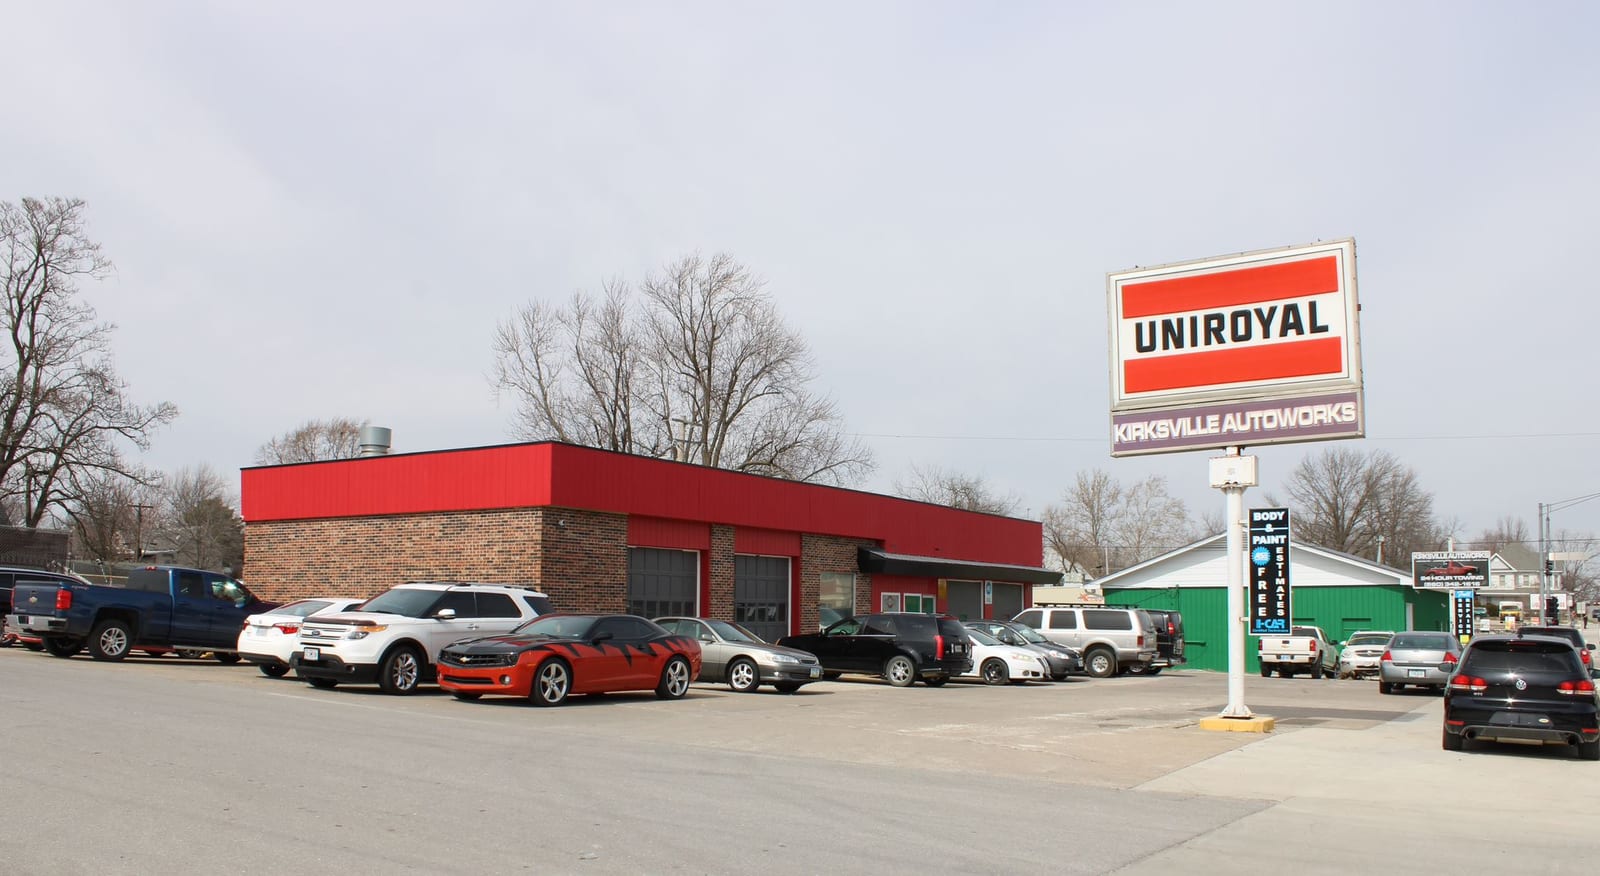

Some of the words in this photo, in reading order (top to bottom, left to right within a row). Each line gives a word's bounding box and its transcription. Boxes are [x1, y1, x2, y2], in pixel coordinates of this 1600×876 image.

[1135, 300, 1329, 353] UNIROYAL
[1114, 414, 1220, 443] KIRKSVILLE
[1222, 401, 1357, 433] AUTOWORKS
[1253, 511, 1285, 521] BODY
[1265, 523, 1274, 532] &
[1252, 535, 1286, 545] PAINT
[1257, 567, 1267, 616] FREE
[1275, 546, 1286, 616] ESTIMATES
